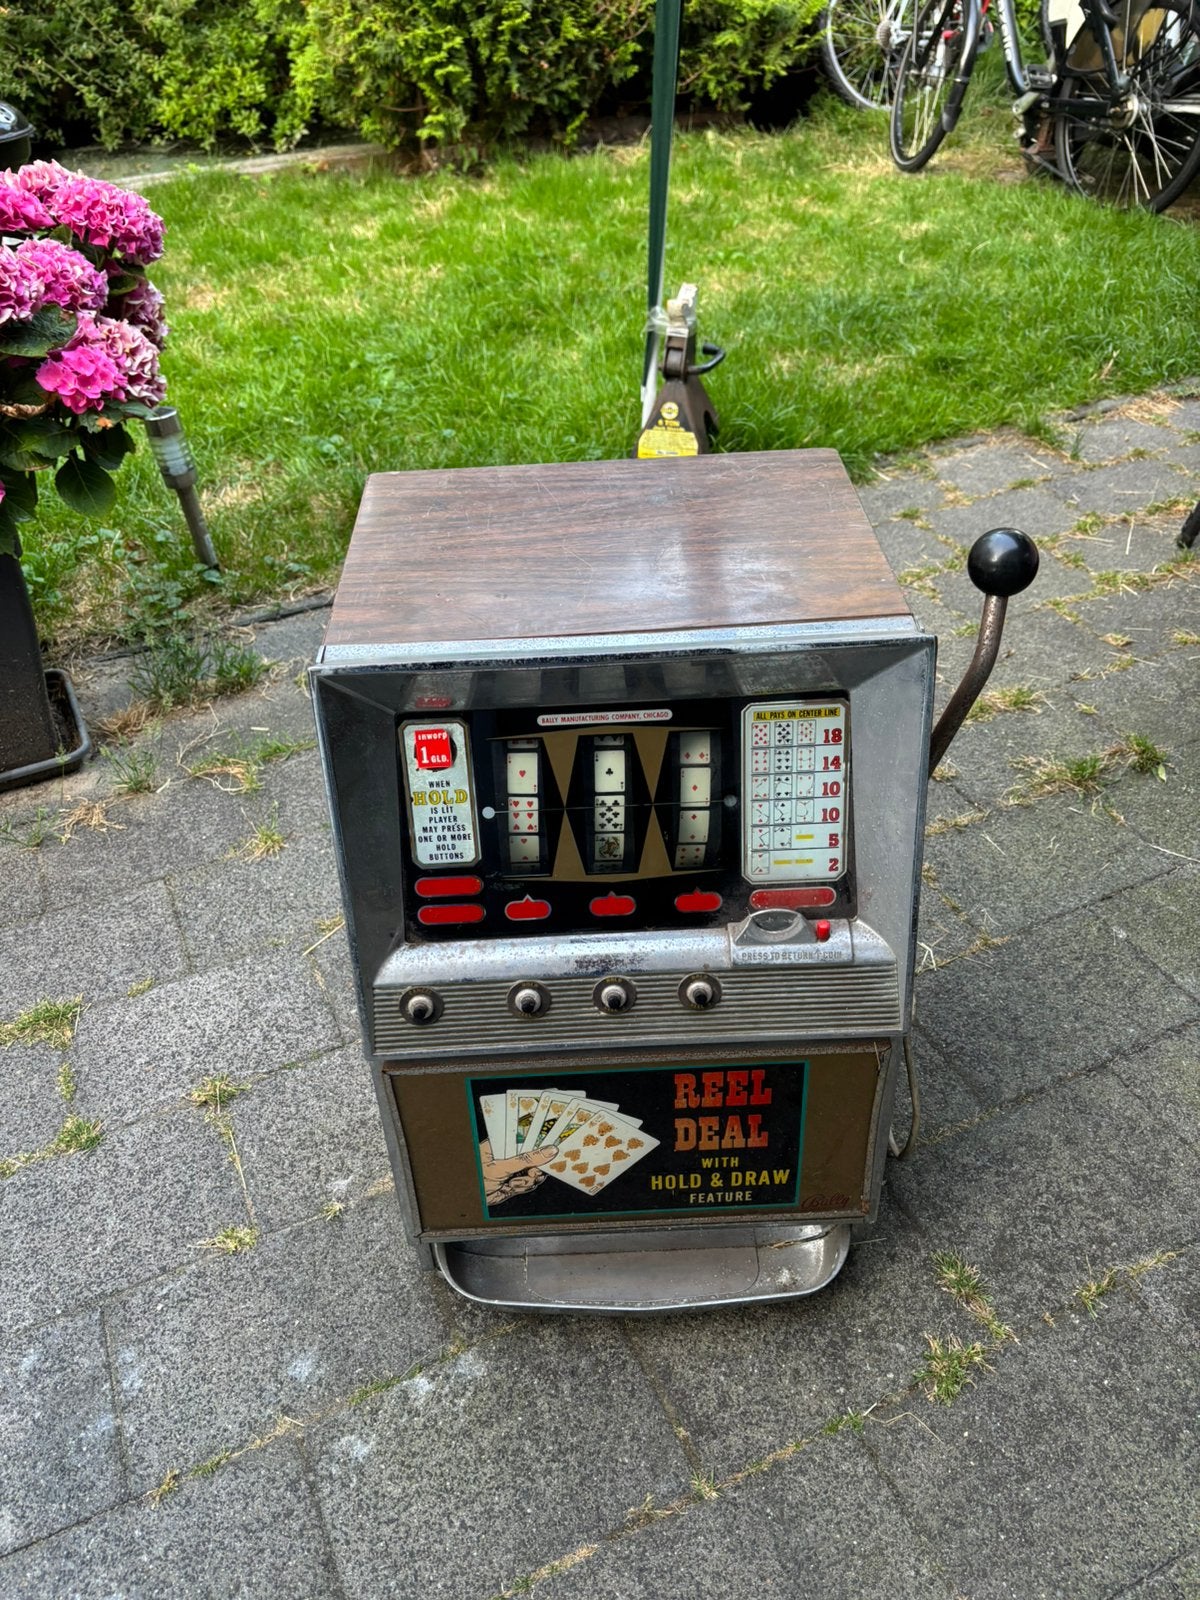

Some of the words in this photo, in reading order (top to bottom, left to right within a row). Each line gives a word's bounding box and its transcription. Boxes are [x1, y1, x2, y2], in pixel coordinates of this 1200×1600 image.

[560, 714, 609, 723] MANUFACTURING
[643, 711, 669, 719] CHICAGO
[756, 712, 767, 720] ALL
[769, 711, 785, 719] PAYS
[787, 710, 796, 718] ON
[799, 709, 822, 717] CENTER
[824, 708, 838, 716] LINE
[823, 728, 842, 743] 18
[421, 746, 429, 763] 1
[823, 755, 842, 770] 14
[428, 780, 450, 788] WHEN
[822, 781, 840, 796] 10
[412, 789, 468, 806] HOLD
[442, 806, 454, 814] LIT
[822, 807, 840, 822] 10
[429, 815, 458, 824] PLAYER
[422, 825, 438, 833] MAY
[442, 824, 466, 832] PRESS
[418, 835, 433, 843] ONE
[437, 834, 447, 842] OR
[451, 833, 472, 842] MORE
[828, 833, 839, 848] 5
[436, 844, 456, 852] HOLD
[429, 852, 464, 861] BUTTONS
[828, 858, 839, 872] 2
[741, 952, 769, 961] PRESS
[781, 951, 813, 960] RETURN
[674, 1069, 772, 1109] REEL
[673, 1114, 769, 1152] DEAL
[701, 1157, 739, 1169] WITH
[651, 1173, 702, 1190] HOLD
[710, 1172, 724, 1188] &
[731, 1169, 791, 1187] DRAW
[689, 1191, 753, 1204] FEATURE
